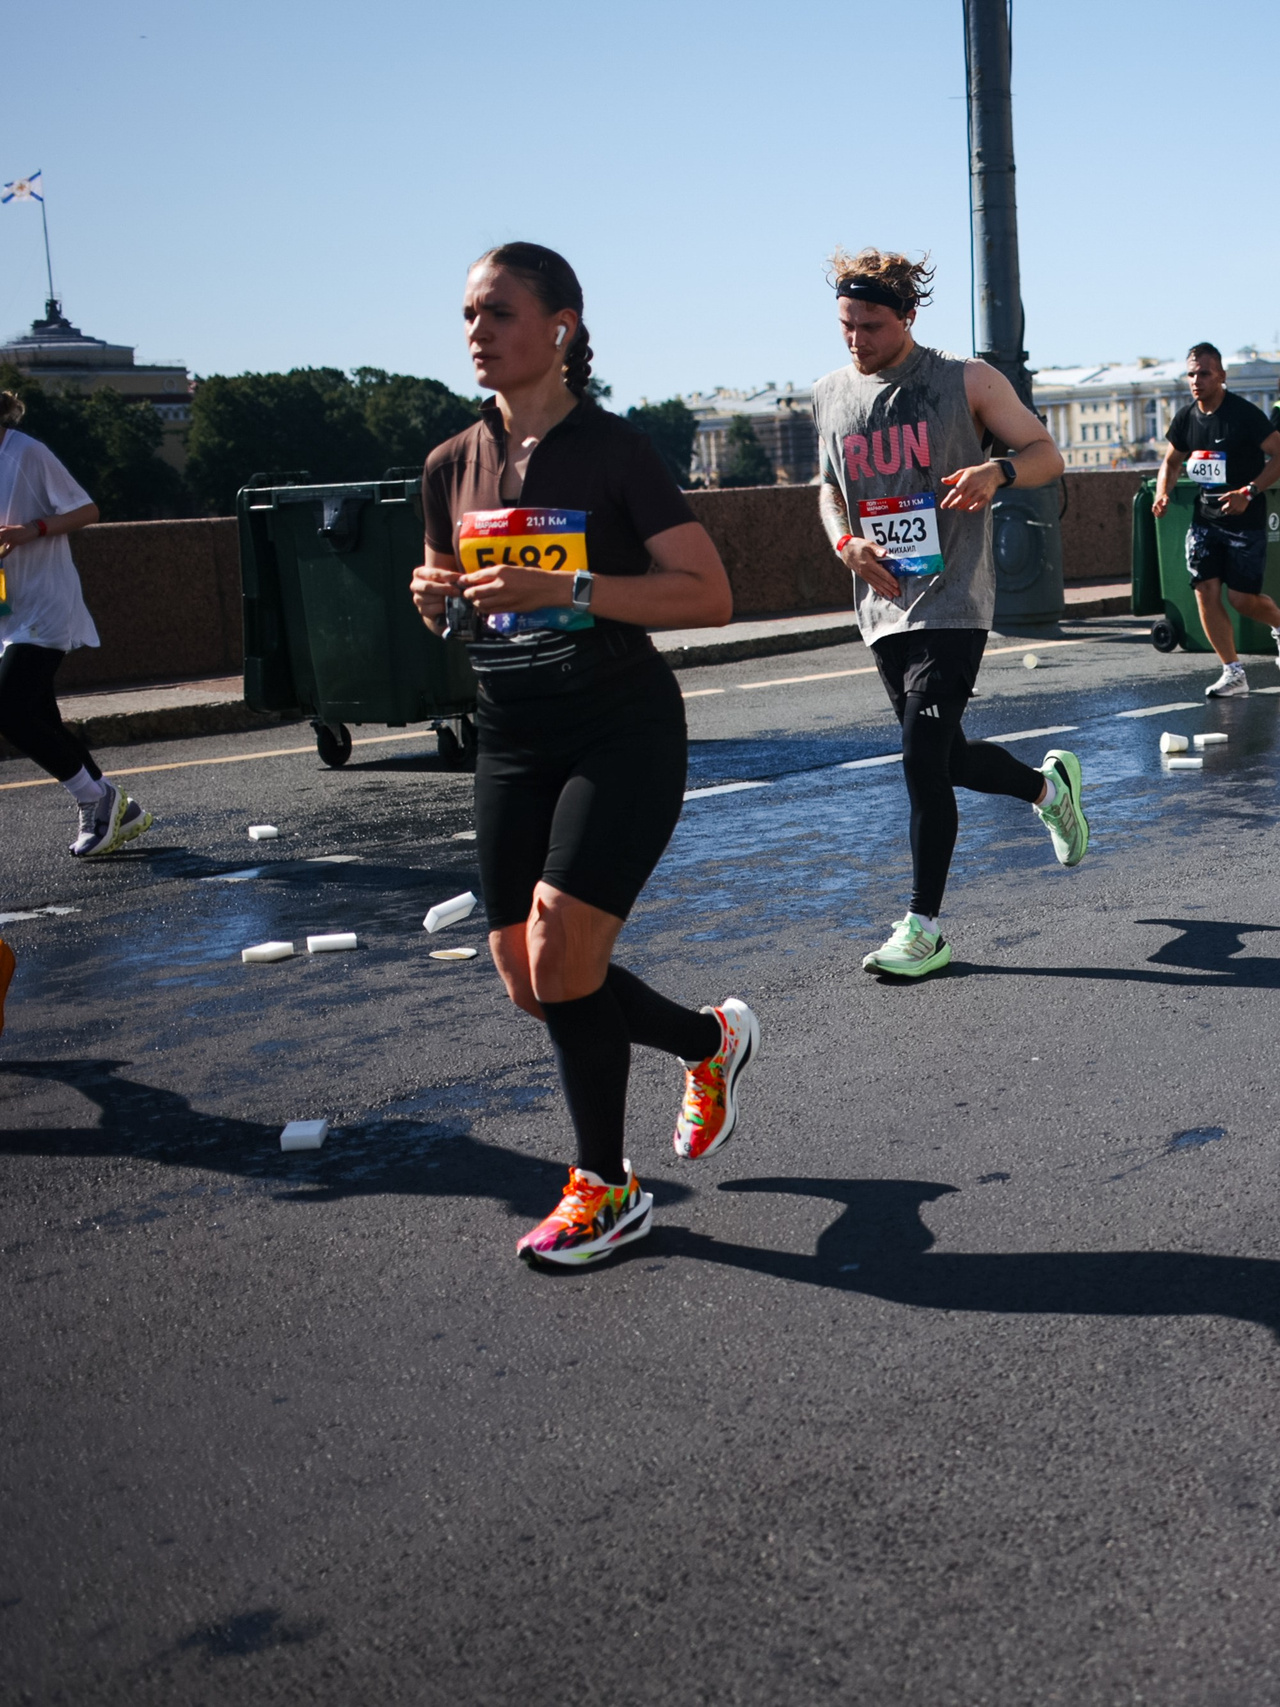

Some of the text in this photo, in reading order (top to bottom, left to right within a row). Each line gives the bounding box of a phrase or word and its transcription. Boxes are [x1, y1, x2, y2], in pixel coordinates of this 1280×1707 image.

[843, 421, 931, 481] RUN
[1192, 463, 1221, 476] 4816
[526, 516, 545, 527] 21,1
[871, 517, 927, 546] 5423
[888, 544, 917, 555] МИХАИЛ
